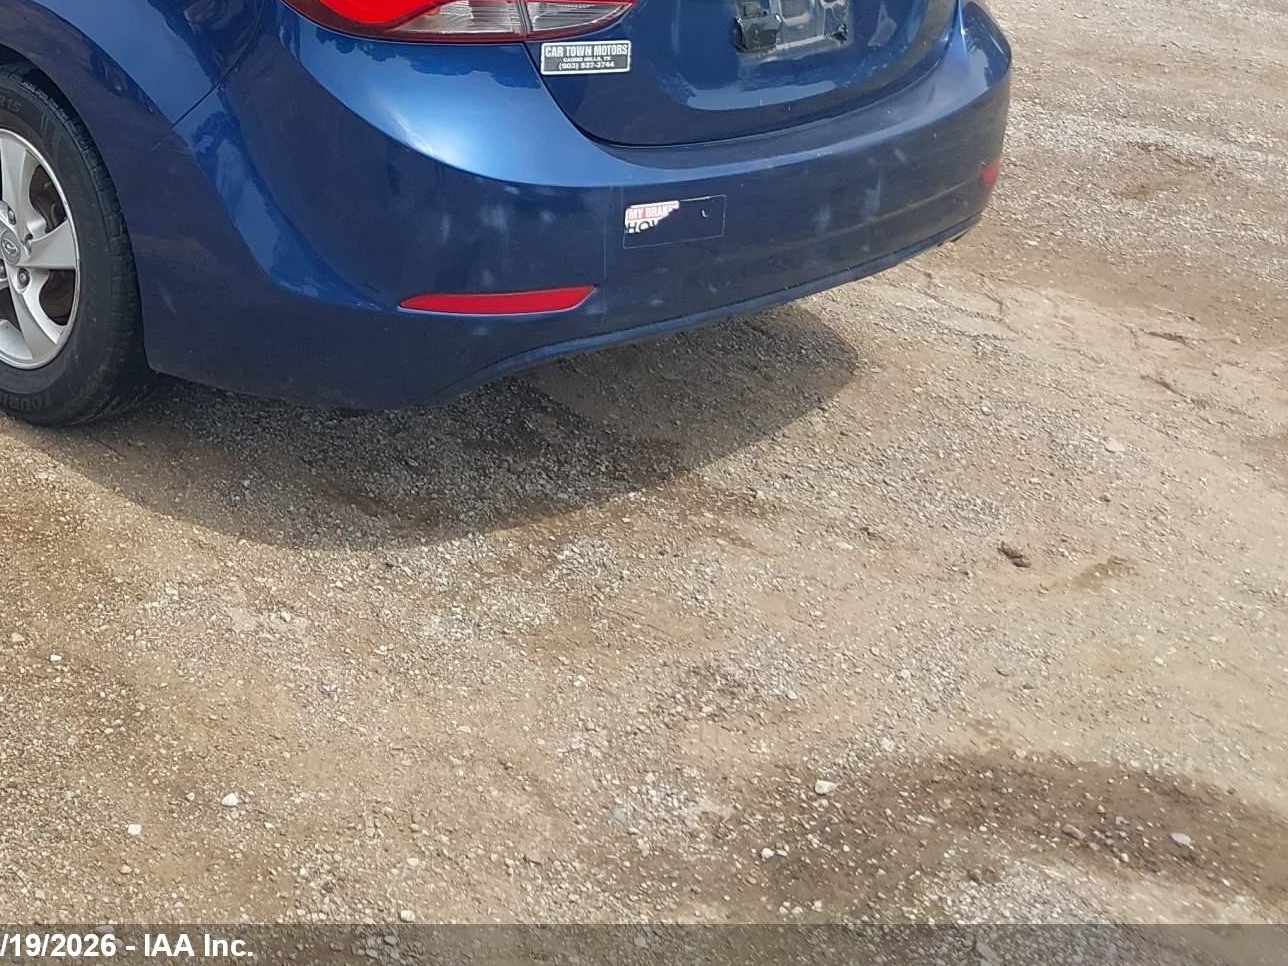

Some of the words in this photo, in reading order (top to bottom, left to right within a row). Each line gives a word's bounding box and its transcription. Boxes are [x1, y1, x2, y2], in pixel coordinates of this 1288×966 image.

[545, 46, 564, 57] CAR
[565, 45, 592, 57] TOWN
[593, 44, 628, 56] MOTORS
[558, 62, 579, 70] (903)
